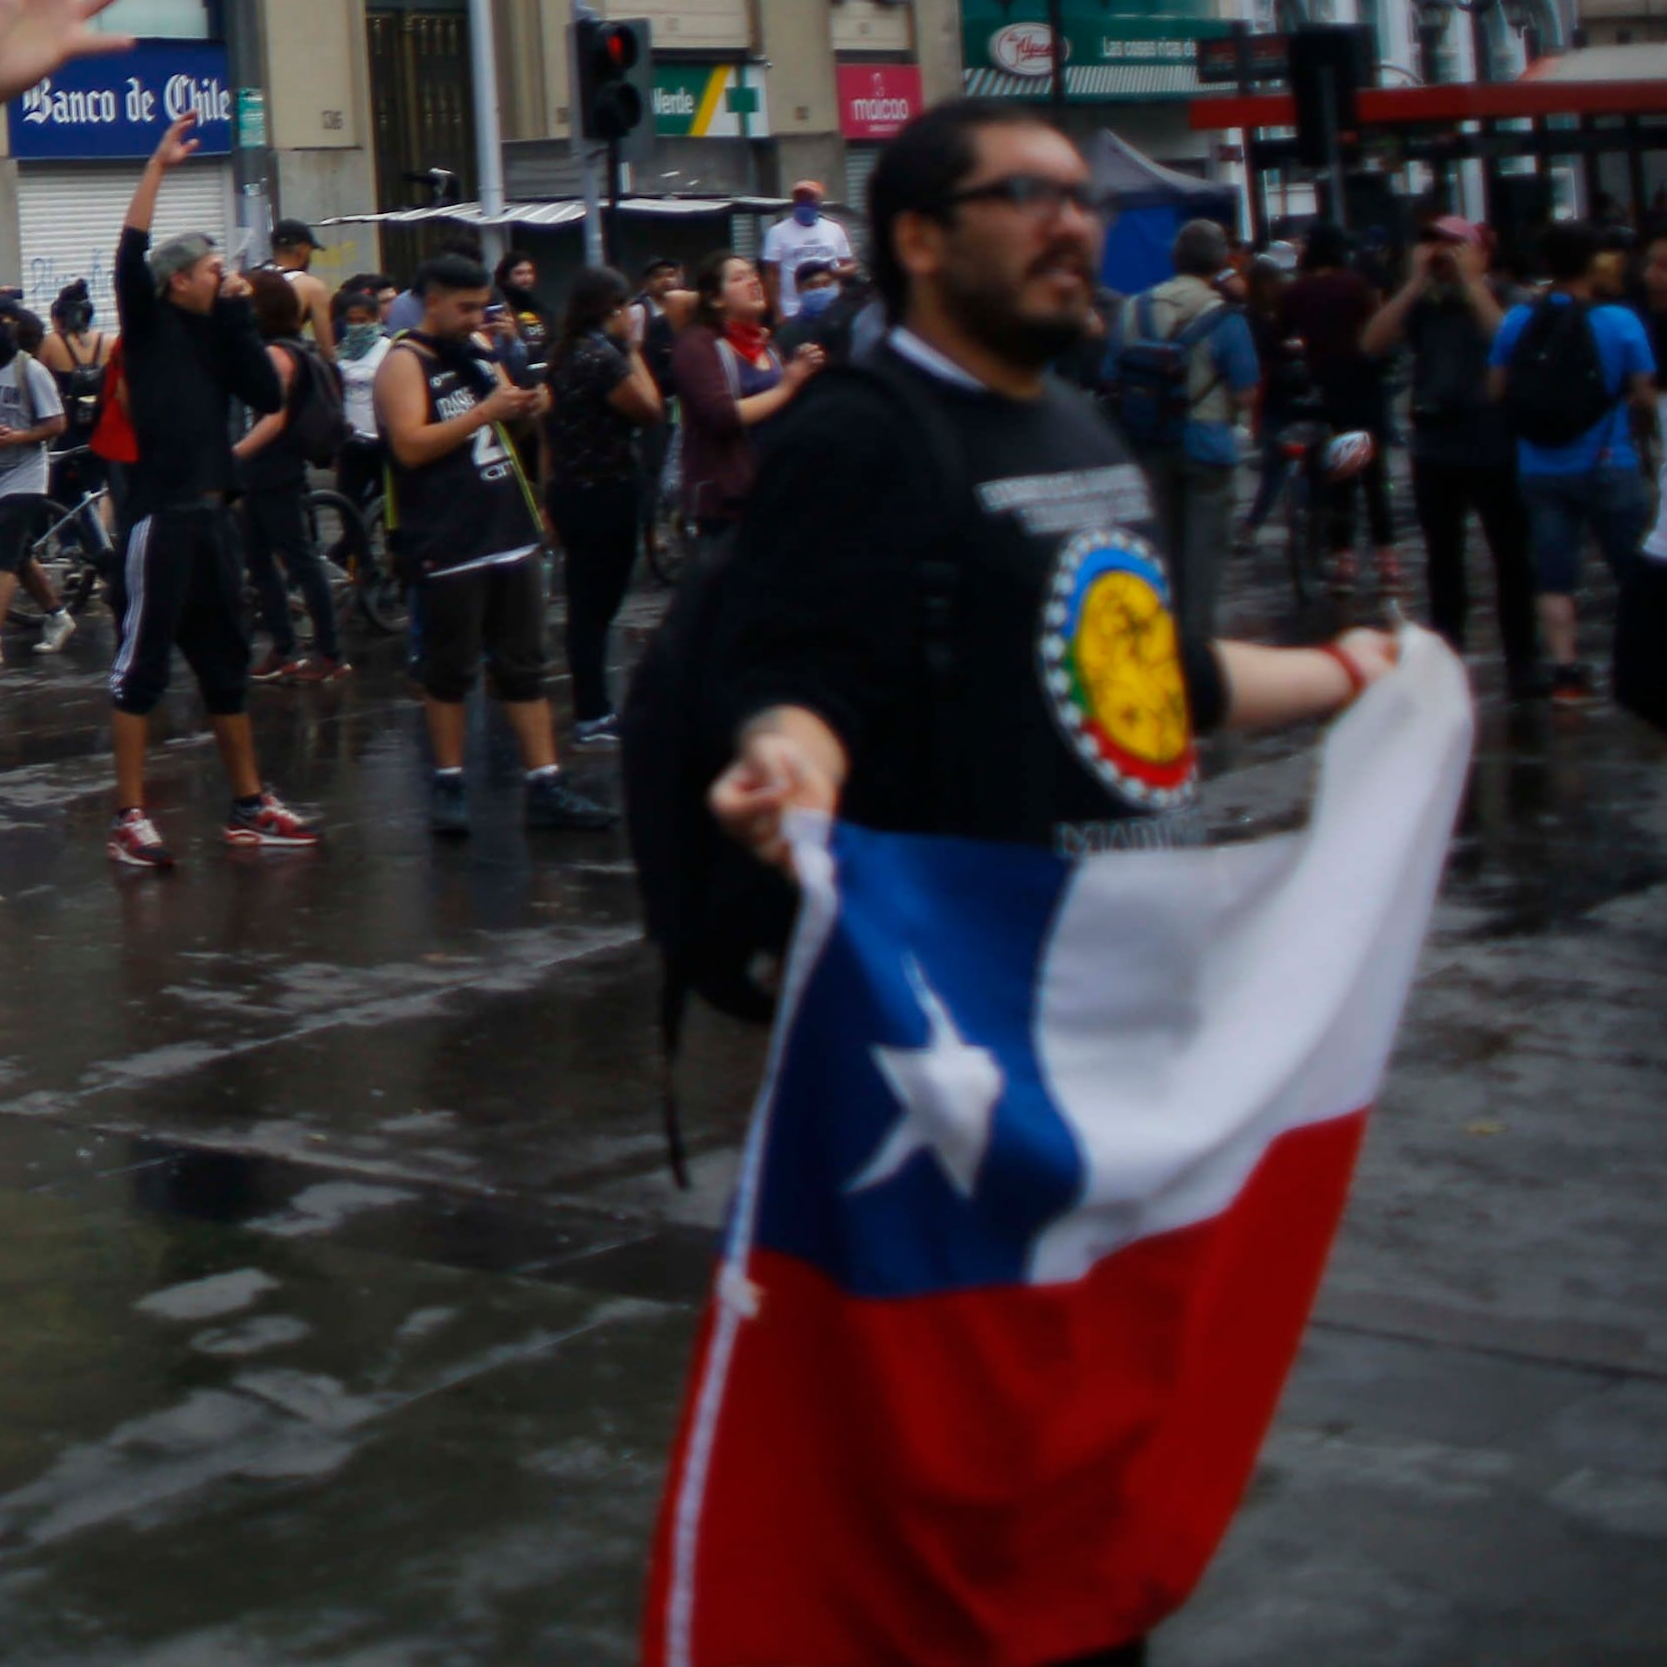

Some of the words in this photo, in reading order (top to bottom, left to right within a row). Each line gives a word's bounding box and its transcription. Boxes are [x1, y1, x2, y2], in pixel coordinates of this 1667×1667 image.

[22, 75, 116, 124] Banco
[126, 77, 156, 122] de
[164, 72, 233, 127] Chile
[653, 86, 695, 116] Verde
[852, 97, 909, 122] maicao
